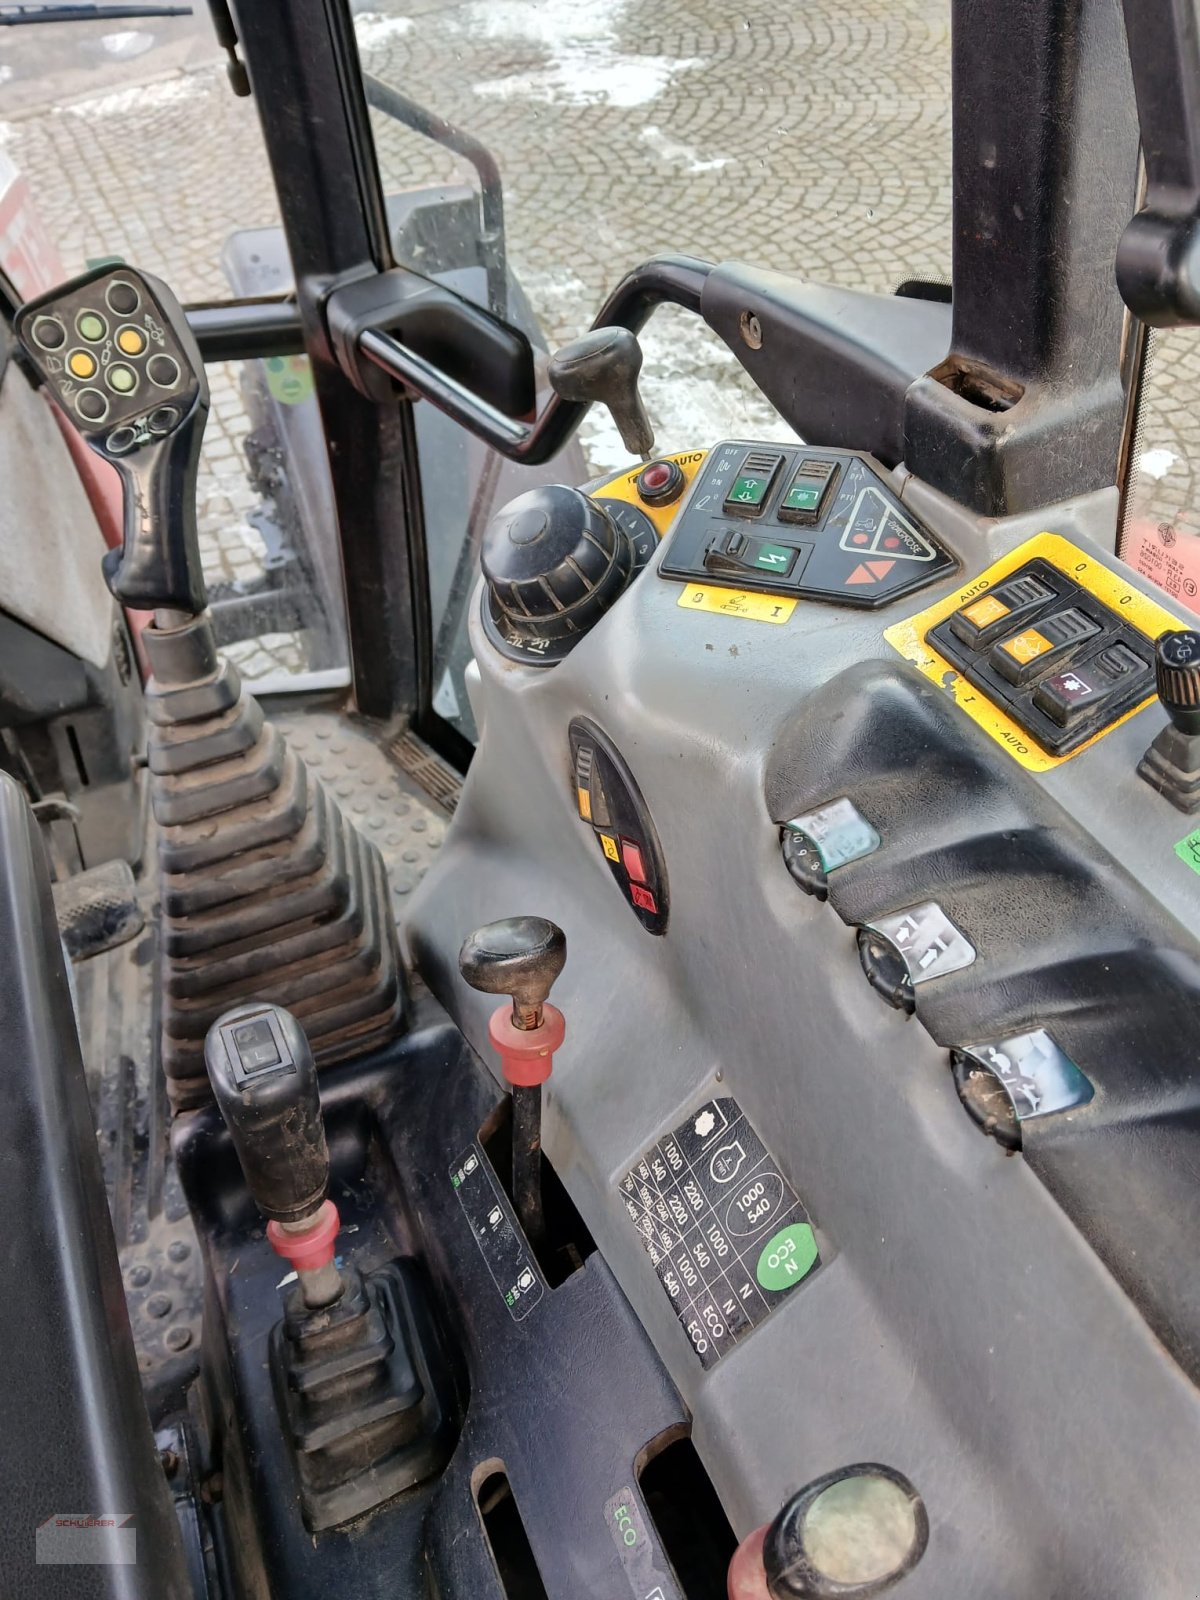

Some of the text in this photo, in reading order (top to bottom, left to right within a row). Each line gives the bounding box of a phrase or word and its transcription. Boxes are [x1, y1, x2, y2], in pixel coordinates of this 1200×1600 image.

[673, 453, 703, 466] AUTO
[628, 520, 638, 529] 4
[887, 520, 923, 554] DIAGNOSE
[639, 544, 648, 555] 3
[960, 581, 990, 603] AUTO
[999, 730, 1029, 755] AUTO
[810, 861, 820, 871] 8
[735, 1182, 765, 1213] 1000
[747, 1198, 771, 1224] 540
[664, 1141, 753, 1300] 1000 2200 1000 N
[651, 1159, 737, 1316] 540 2200 540 N
[767, 1238, 797, 1269] ECO
[676, 1252, 698, 1288] 1000
[702, 1304, 724, 1338] ECO
[663, 1272, 680, 1298] 540
[686, 1320, 708, 1354] ECO
[614, 1505, 637, 1547] ECO
